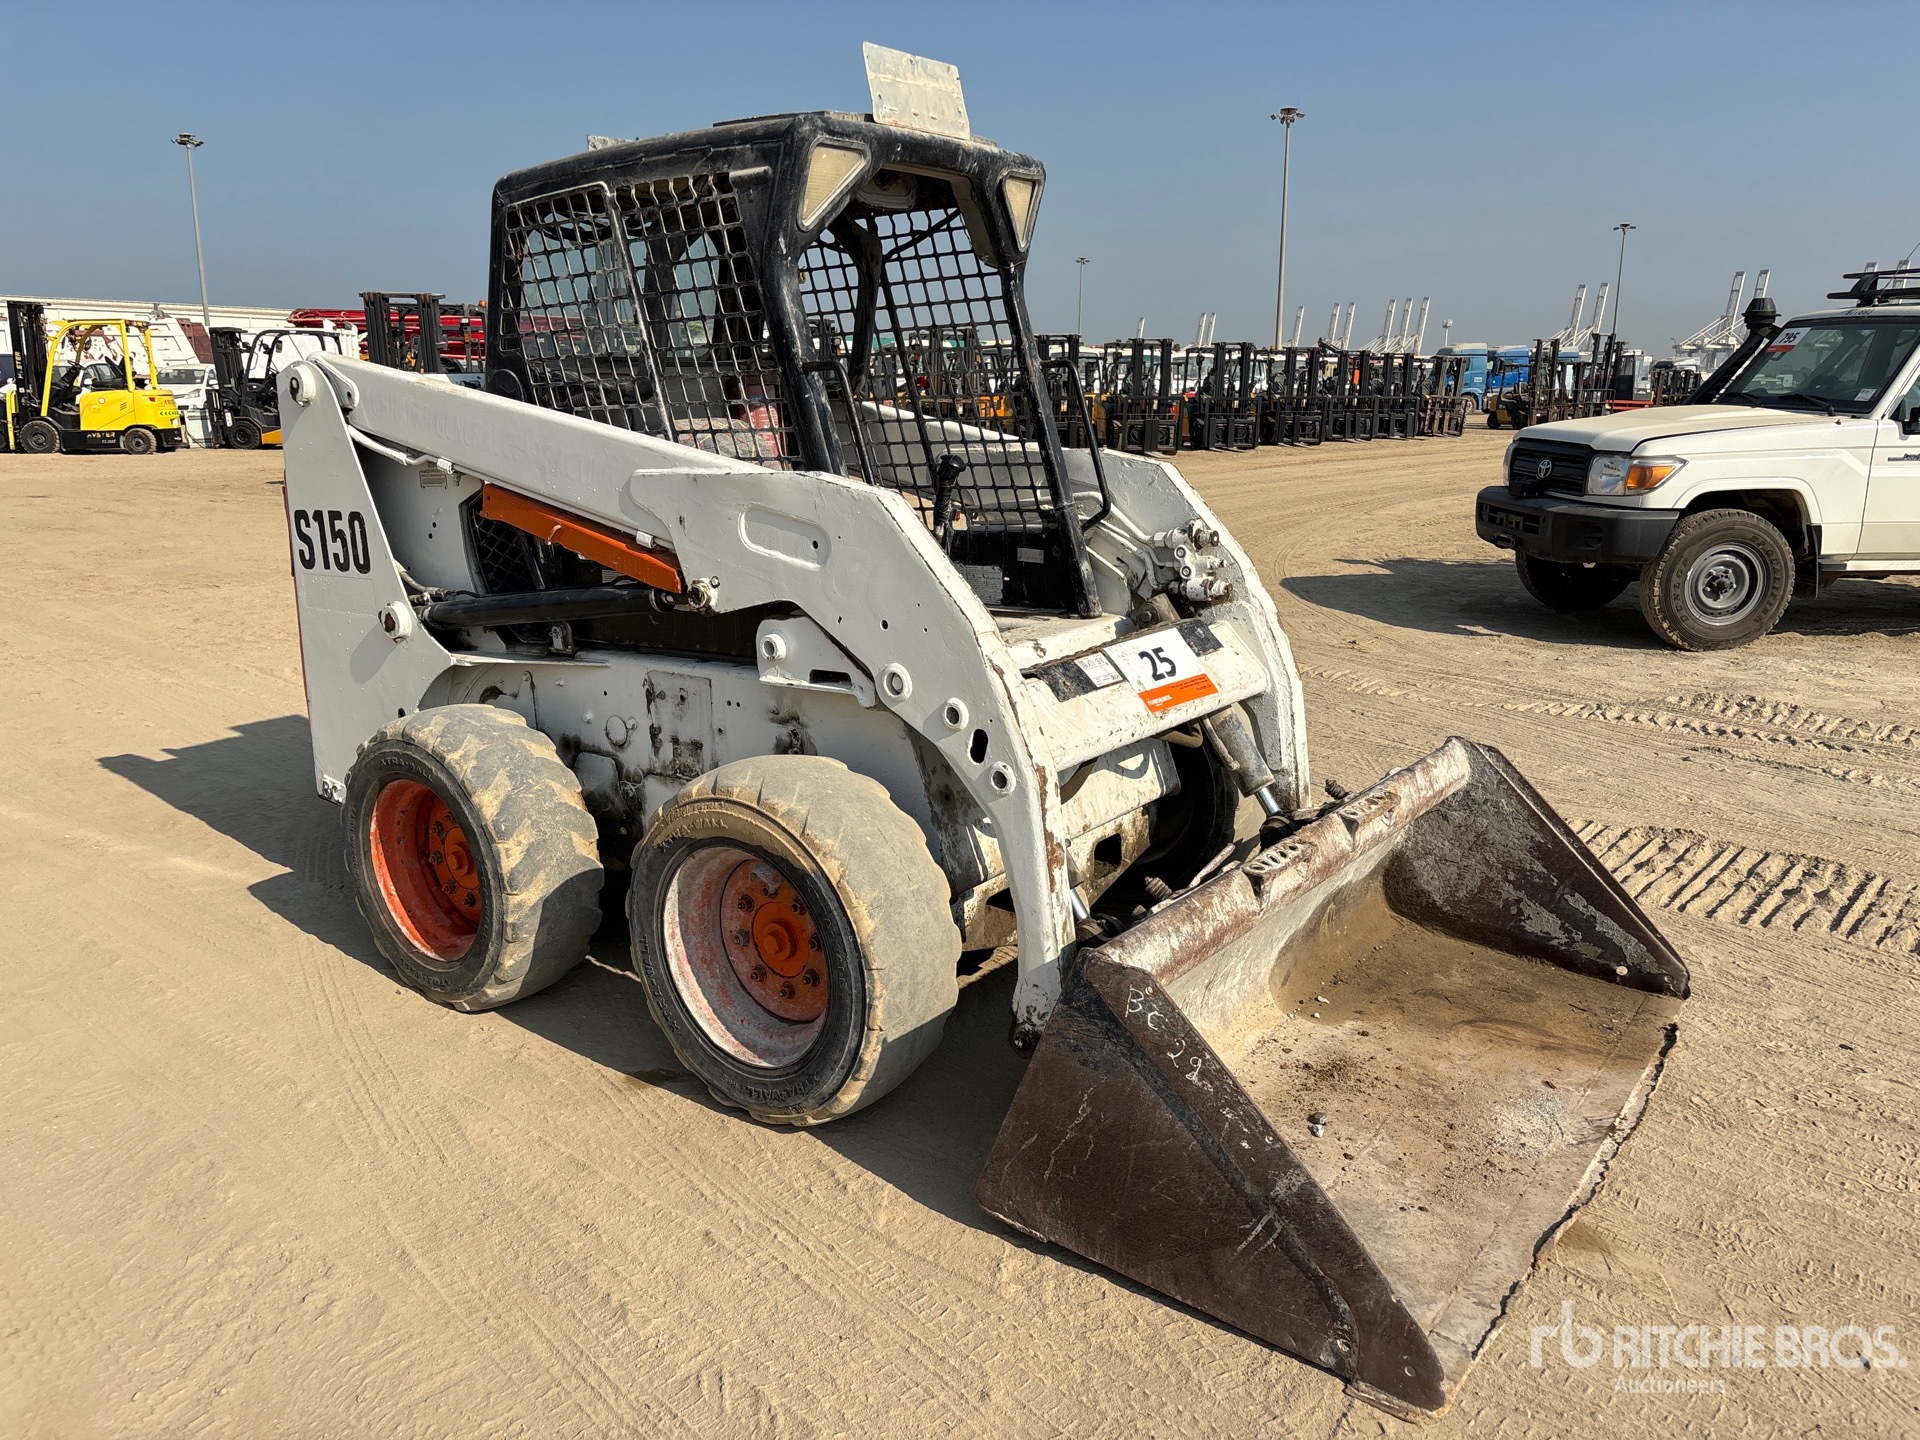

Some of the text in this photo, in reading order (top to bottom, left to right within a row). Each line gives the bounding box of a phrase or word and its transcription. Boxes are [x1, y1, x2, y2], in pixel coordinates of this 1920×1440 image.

[1778, 332, 1800, 343] 795
[294, 509, 371, 575] S150
[1673, 557, 1689, 622] DUNLOP
[1138, 646, 1176, 681] 25
[380, 756, 434, 783] XTRA-WALL
